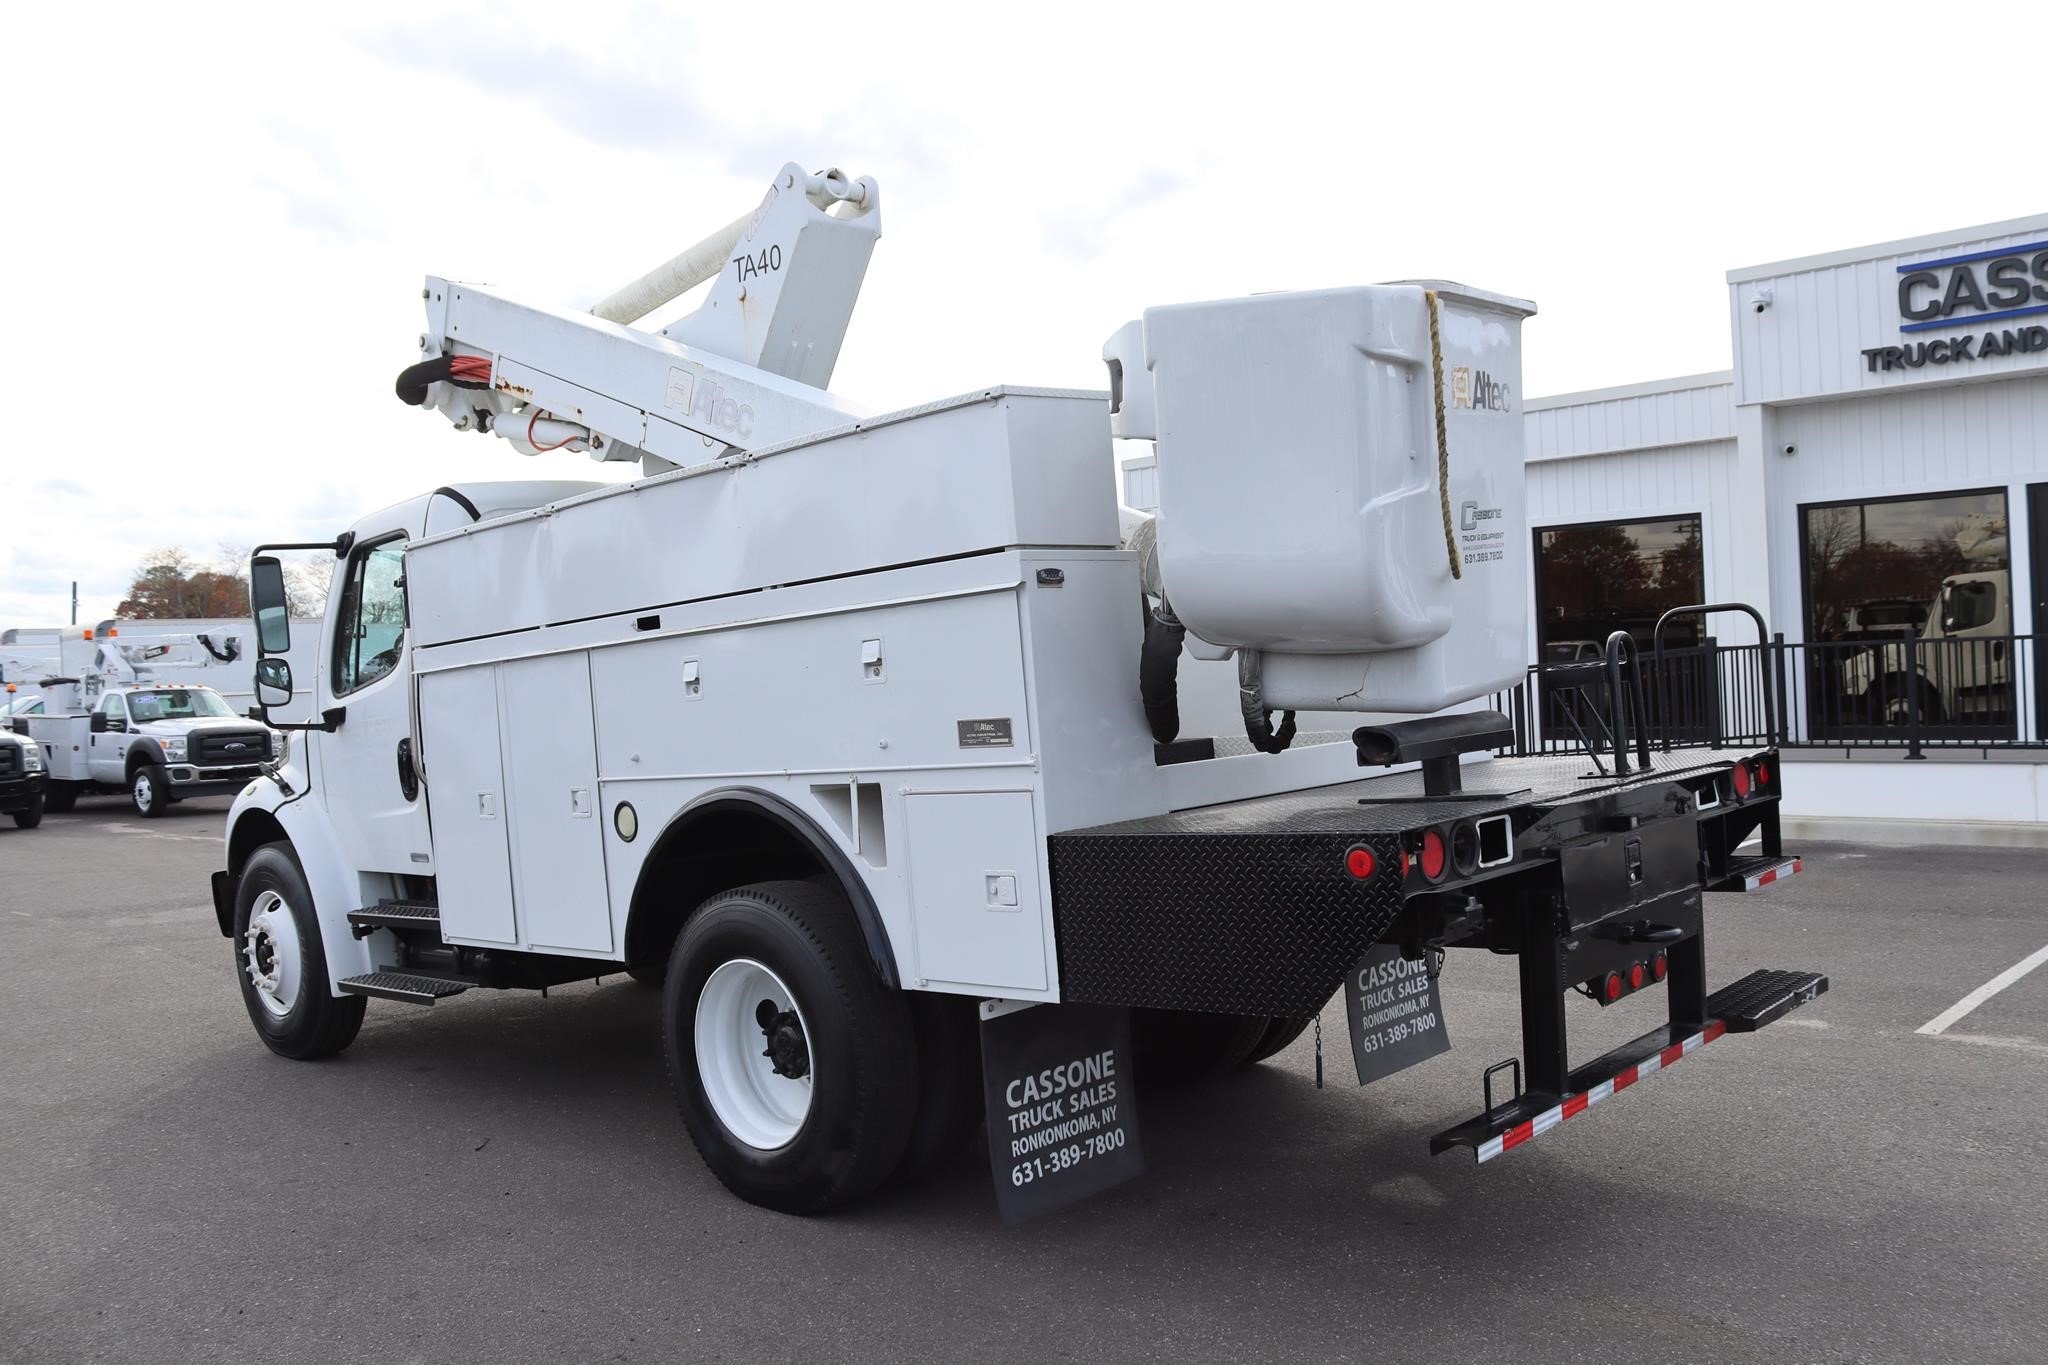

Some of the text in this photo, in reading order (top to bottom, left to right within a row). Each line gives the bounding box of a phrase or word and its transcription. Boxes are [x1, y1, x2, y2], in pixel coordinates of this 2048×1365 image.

[733, 244, 782, 283] TA40
[1861, 325, 2048, 372] TRUCK AND
[1472, 370, 1510, 412] Altec
[1360, 975, 1429, 1011] TRUCK SALES
[1363, 993, 1430, 1030] RONKONKOMA, NY
[1364, 1012, 1436, 1053] 631-389-7800
[1006, 1050, 1115, 1108] CASSONE
[1008, 1081, 1116, 1134] TRUCK SALES
[1011, 1105, 1117, 1157] RONKONKOMA, NY
[1011, 1127, 1125, 1187] 631-389-7800
